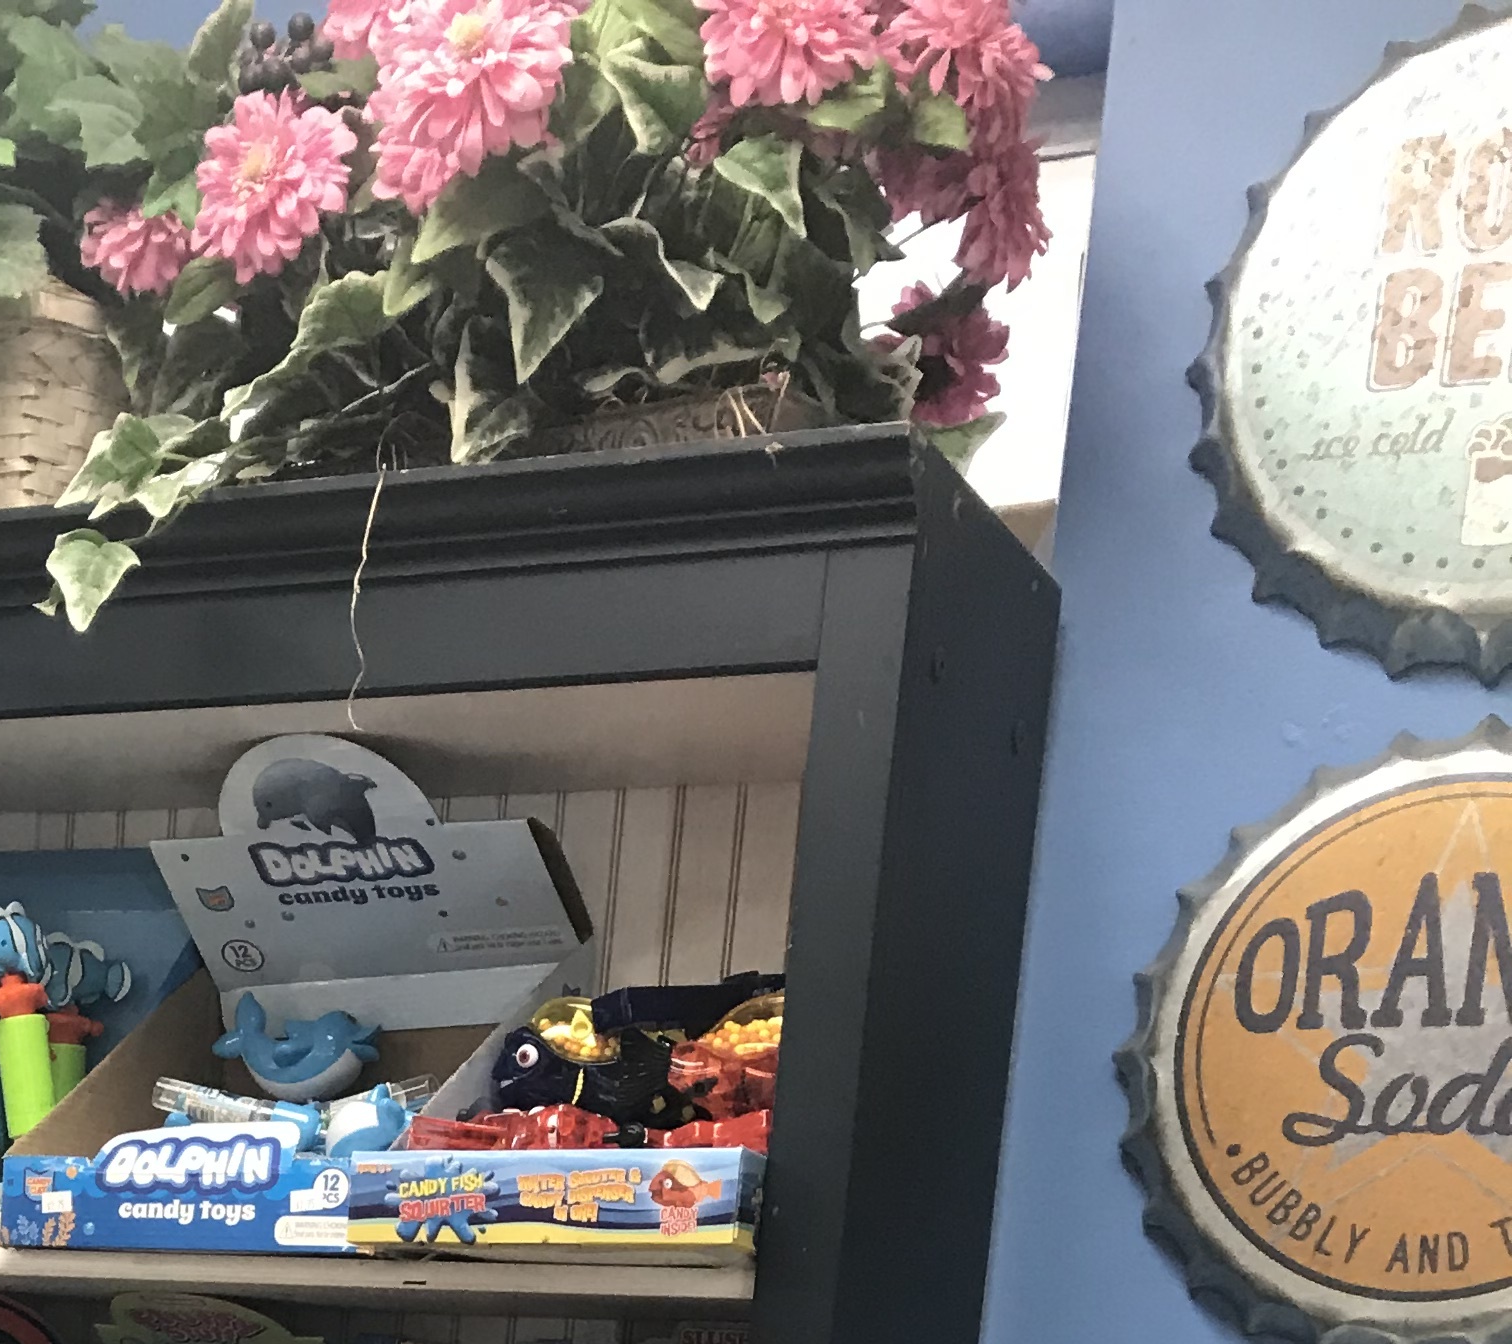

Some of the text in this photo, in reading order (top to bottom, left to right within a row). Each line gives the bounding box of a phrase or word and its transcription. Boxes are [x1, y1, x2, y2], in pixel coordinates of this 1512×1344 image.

[1380, 134, 1512, 256] RO
[1367, 262, 1512, 392] BE
[1368, 413, 1450, 459] cold
[254, 840, 426, 881] DOLPHIN
[278, 881, 441, 907] candy toys
[1234, 872, 1512, 1033] ORAN
[104, 1140, 273, 1189] DOLPHIN
[323, 1174, 341, 1191] 12
[399, 1169, 485, 1198] CANDY FISH
[118, 1199, 256, 1226] candy toys
[399, 1193, 486, 1223] SQUIRTER
[1230, 1151, 1370, 1263] BUBBLY
[1390, 1231, 1468, 1275] AND
